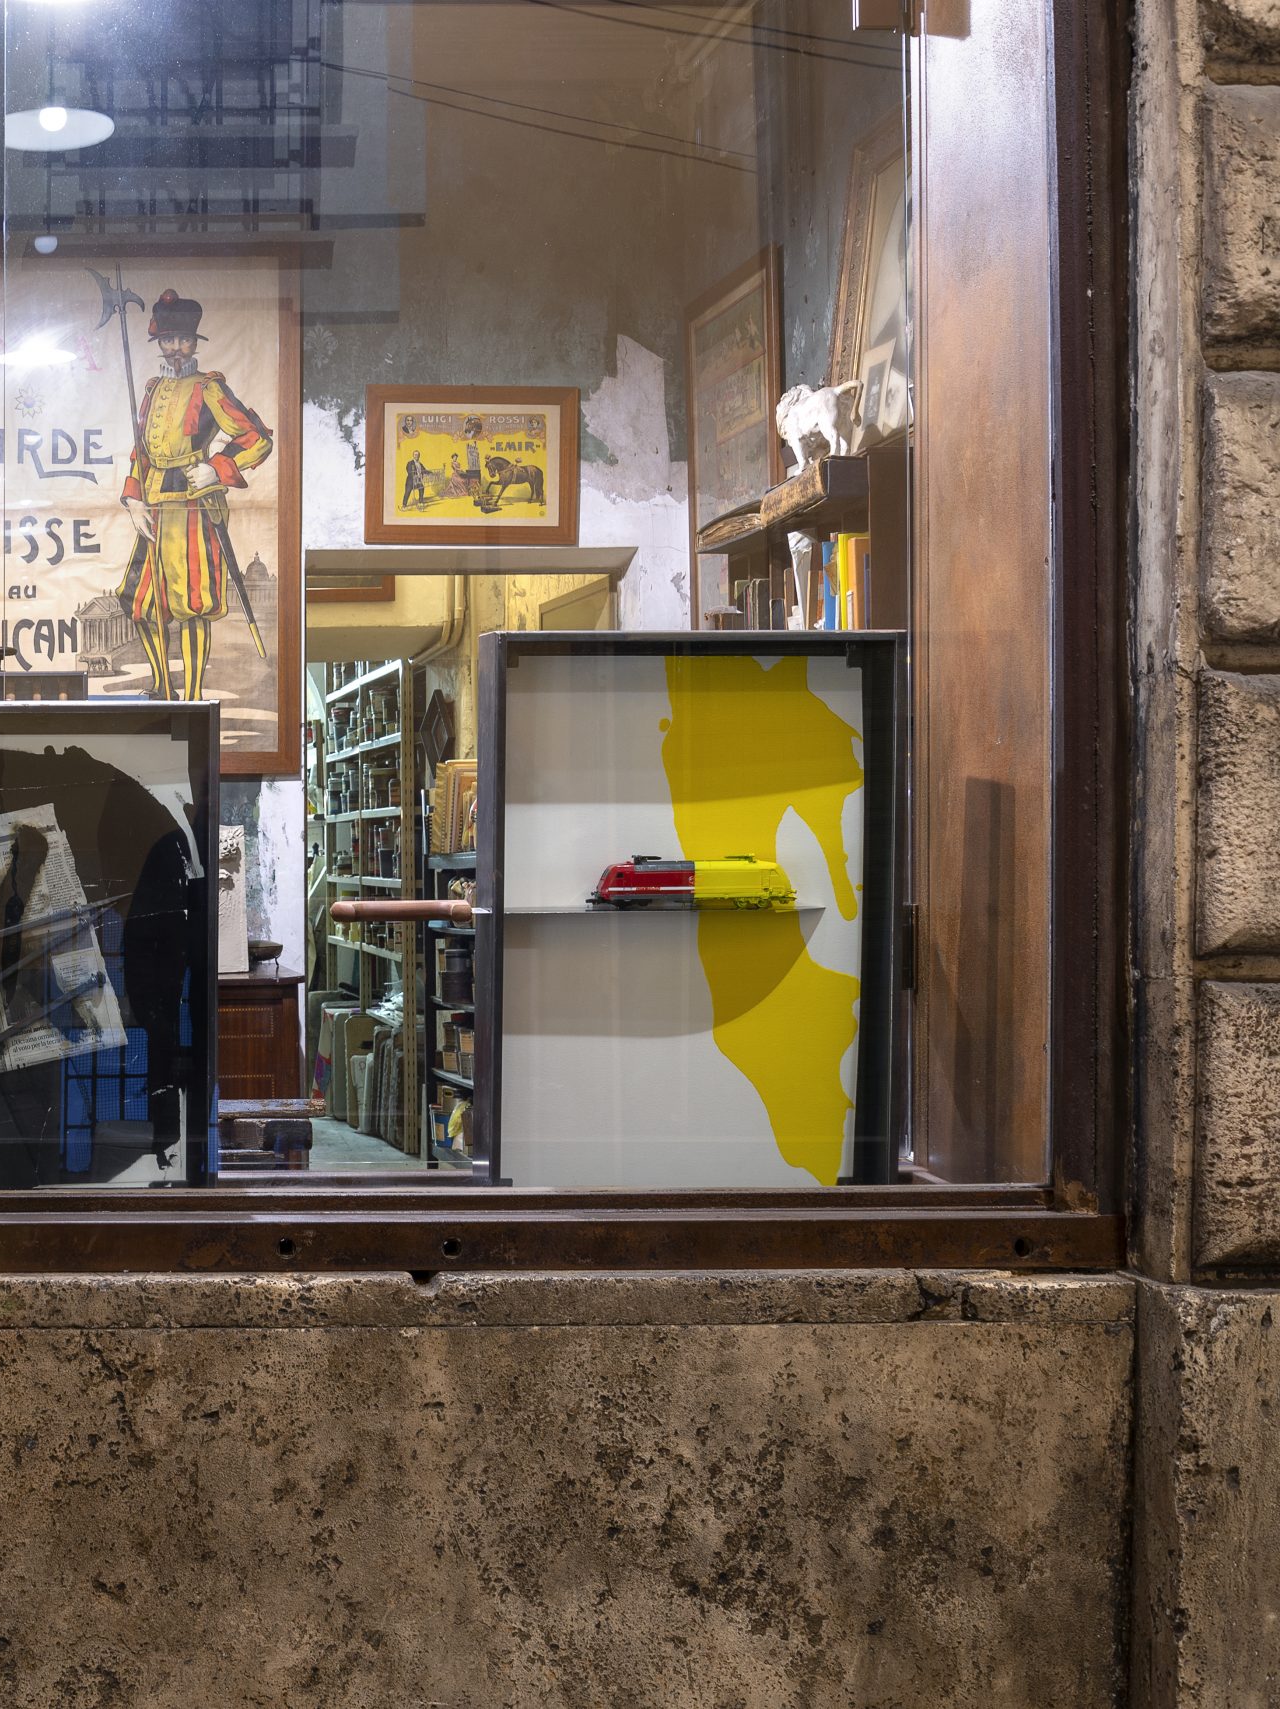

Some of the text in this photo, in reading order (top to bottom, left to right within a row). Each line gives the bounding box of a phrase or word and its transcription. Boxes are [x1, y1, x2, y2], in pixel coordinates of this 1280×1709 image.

[422, 415, 526, 424] LUIGI ROSSI
[8, 585, 37, 600] AU
